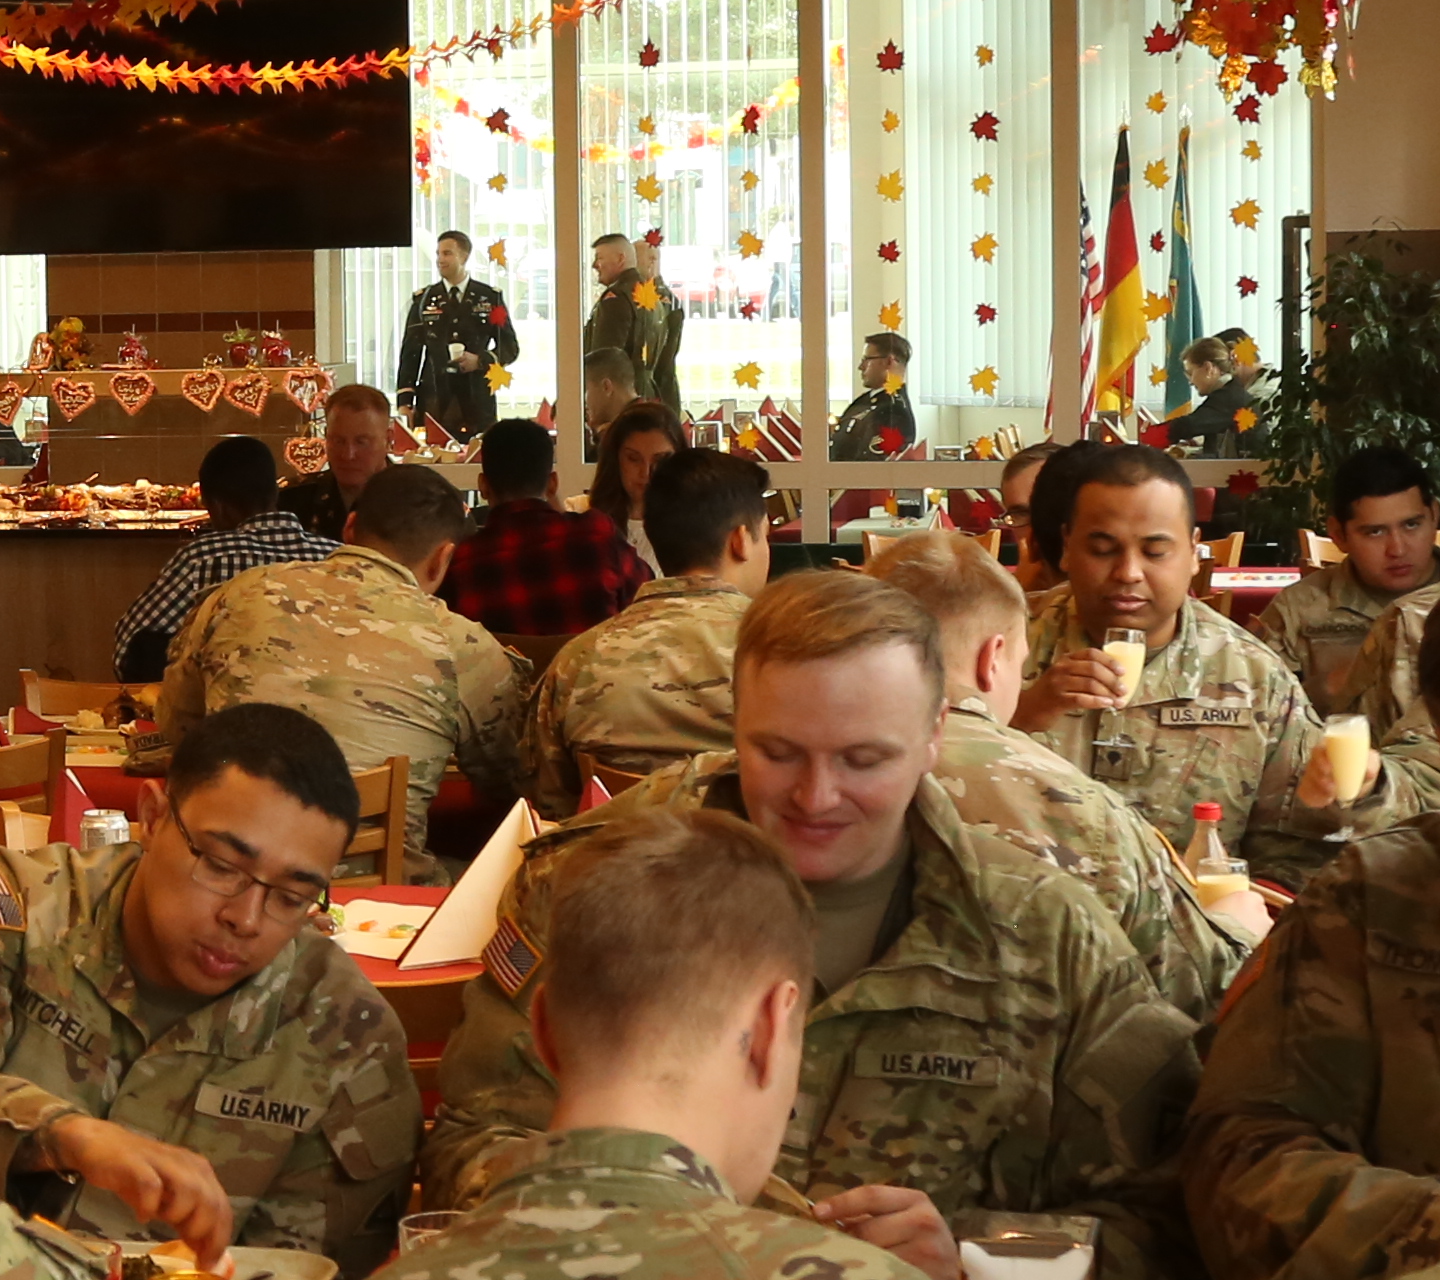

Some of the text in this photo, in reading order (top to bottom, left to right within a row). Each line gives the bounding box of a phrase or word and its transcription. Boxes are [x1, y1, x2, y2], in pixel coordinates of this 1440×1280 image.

[1200, 709, 1241, 723] ARMY
[916, 1054, 978, 1081] ARMY
[251, 1099, 311, 1128] ARMY
